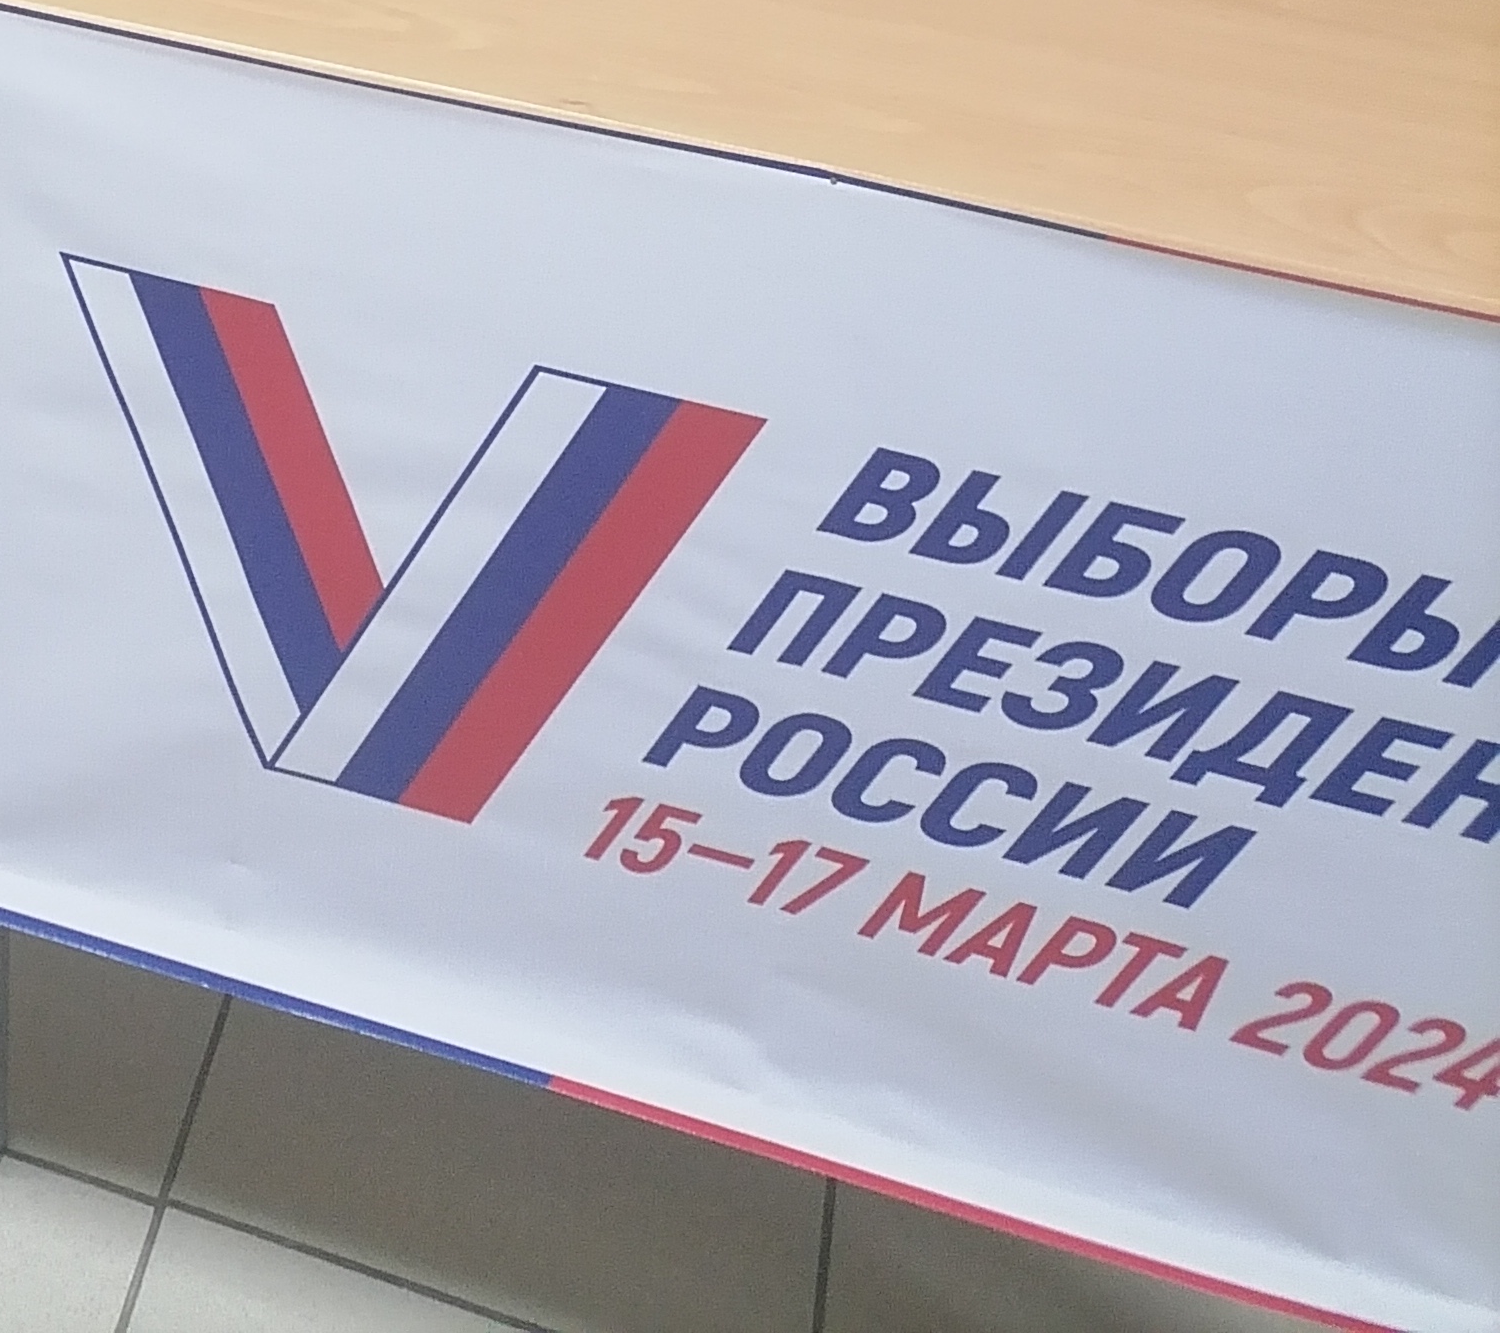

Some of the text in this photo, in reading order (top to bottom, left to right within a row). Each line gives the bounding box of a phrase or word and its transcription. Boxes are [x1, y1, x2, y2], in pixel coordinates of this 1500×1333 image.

[817, 446, 1500, 690] ВЫБОРЫ
[642, 684, 1258, 910] РОССИИ
[857, 872, 1229, 1032] МАРТА
[1229, 981, 1500, 1111] 2024
